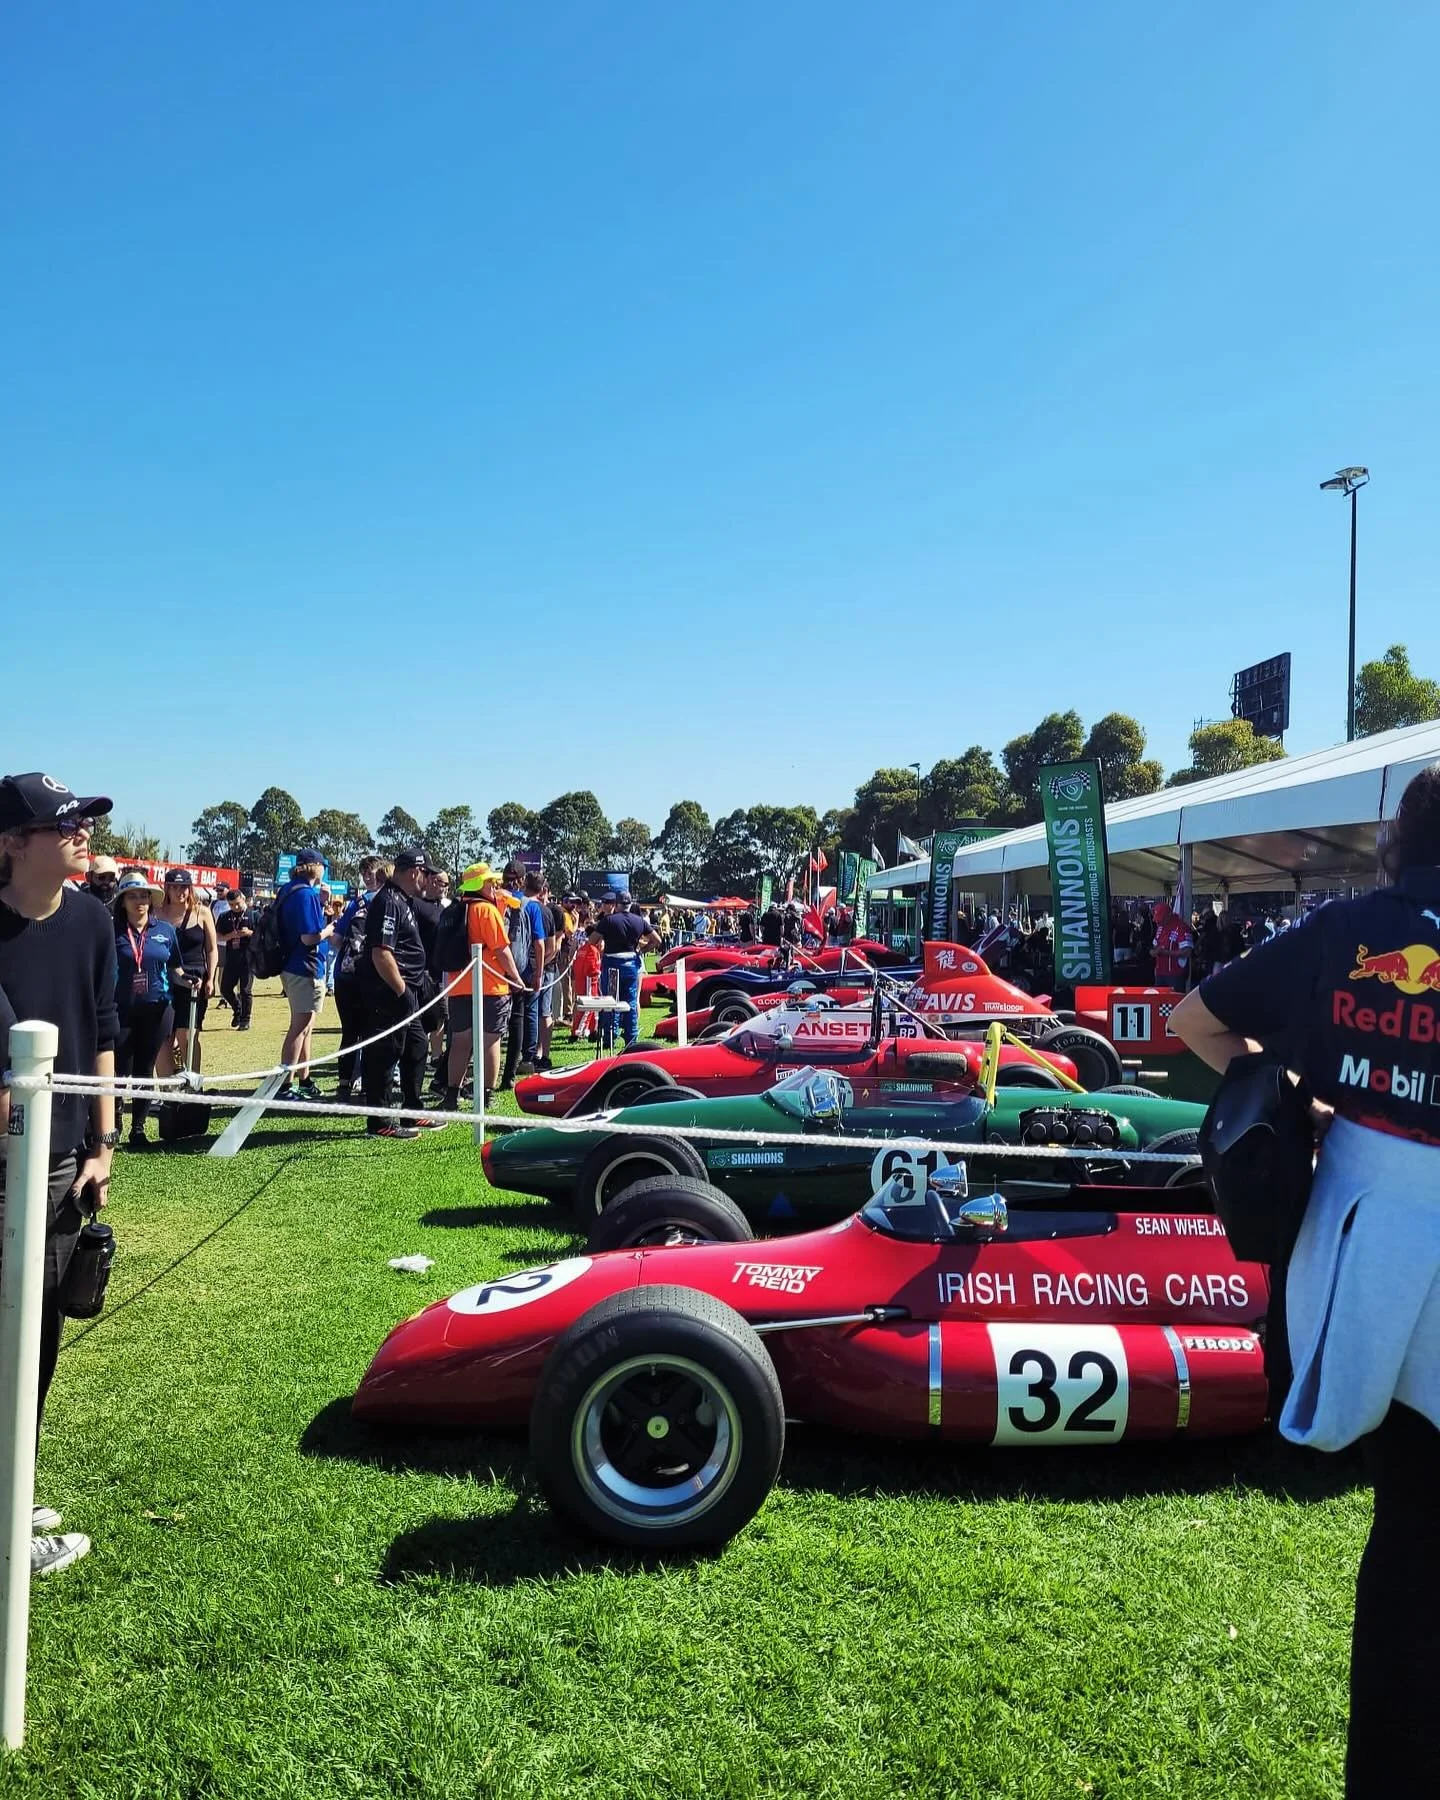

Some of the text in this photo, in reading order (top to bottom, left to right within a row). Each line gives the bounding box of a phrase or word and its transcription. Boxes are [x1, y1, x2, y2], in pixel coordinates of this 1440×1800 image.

[201, 870, 218, 886] BAR
[932, 863, 952, 941] HANNONS
[1052, 819, 1091, 980] SHANNONS
[1084, 817, 1103, 981] INSURANCE FOR MOTORING ENTHUSIASTS
[924, 993, 976, 1011] AVIS
[1332, 990, 1404, 1038] Red
[900, 1027, 915, 1039] BP
[1117, 1006, 1144, 1038] 11
[896, 1083, 933, 1093] SHANNONS
[1338, 1054, 1426, 1103] Mobil
[731, 1151, 784, 1165] SHANNONS
[882, 1150, 937, 1203] 61
[1135, 1217, 1171, 1235] SEAN
[732, 1262, 824, 1283] TOMMY
[748, 1275, 806, 1294] REID
[937, 1272, 1249, 1307] IRISH RACING CARS
[1184, 1337, 1255, 1351] FERODO
[1008, 1348, 1118, 1433] 32
